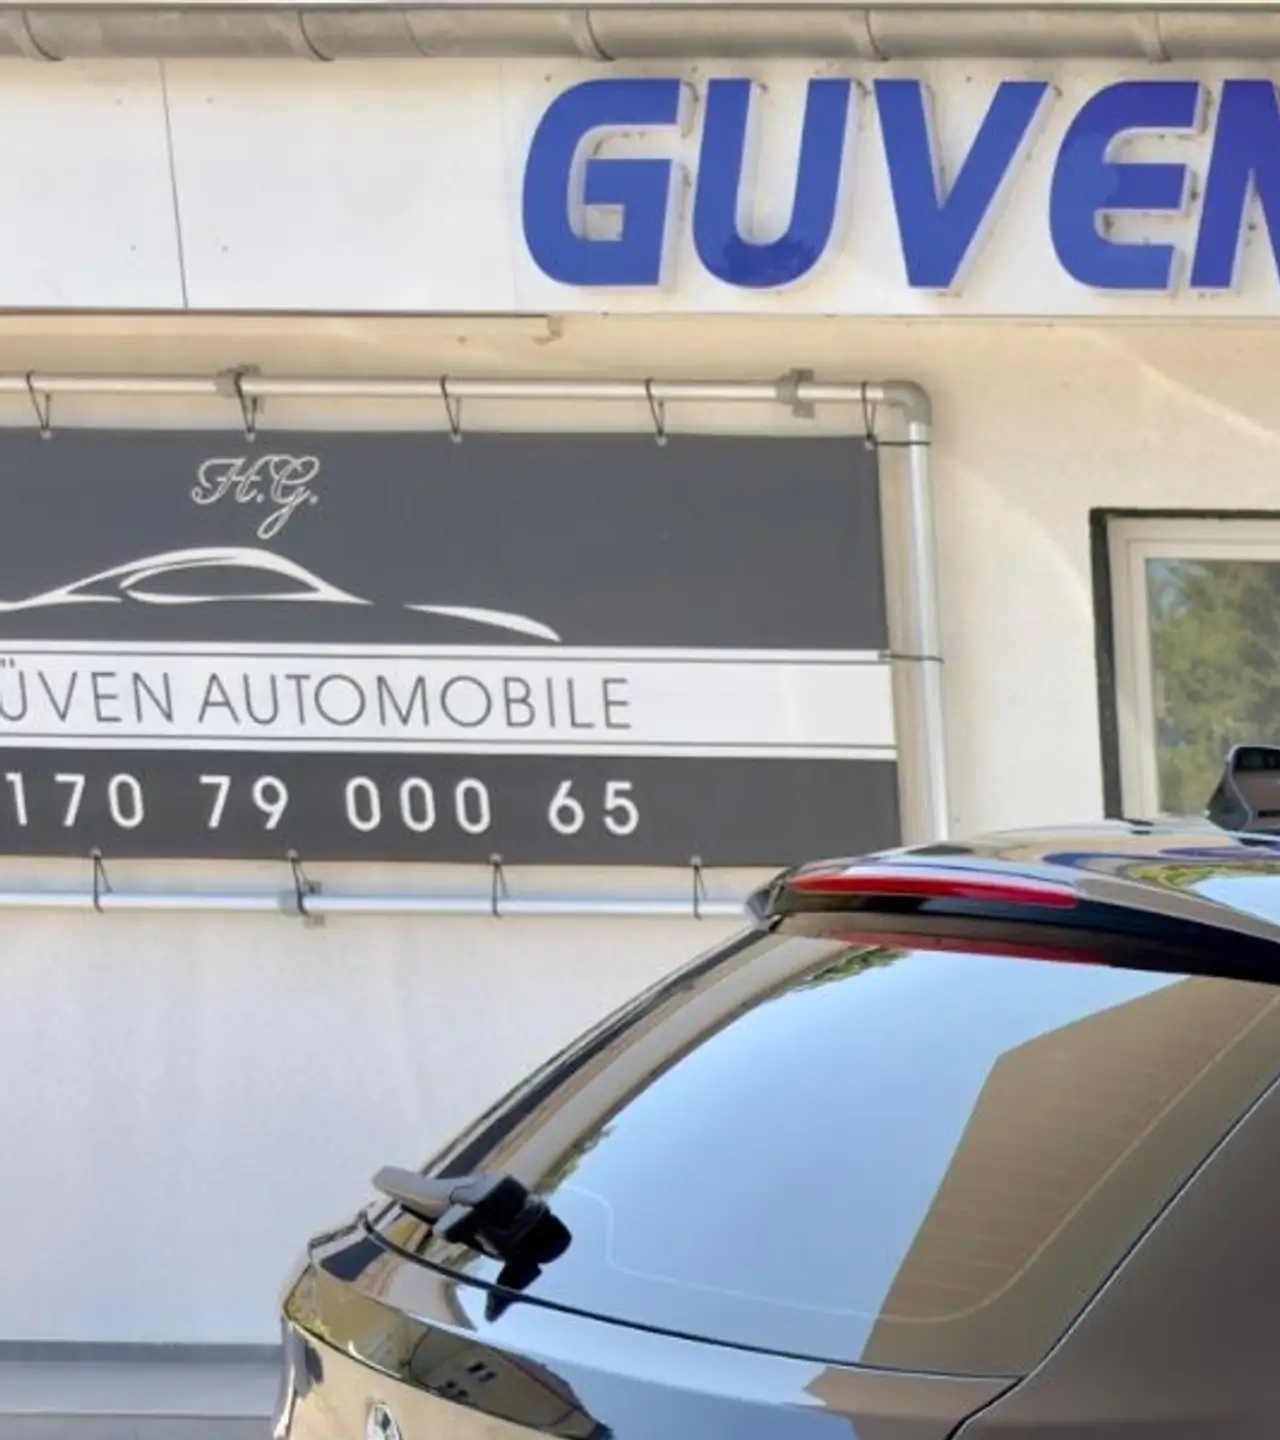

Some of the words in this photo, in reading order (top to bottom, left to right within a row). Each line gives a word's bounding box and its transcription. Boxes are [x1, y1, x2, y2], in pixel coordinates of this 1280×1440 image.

[198, 672, 632, 729] AUTOMOBILE
[5, 771, 145, 828] 170
[199, 774, 289, 830] 79
[345, 776, 491, 834] 000
[548, 779, 640, 835] 65
